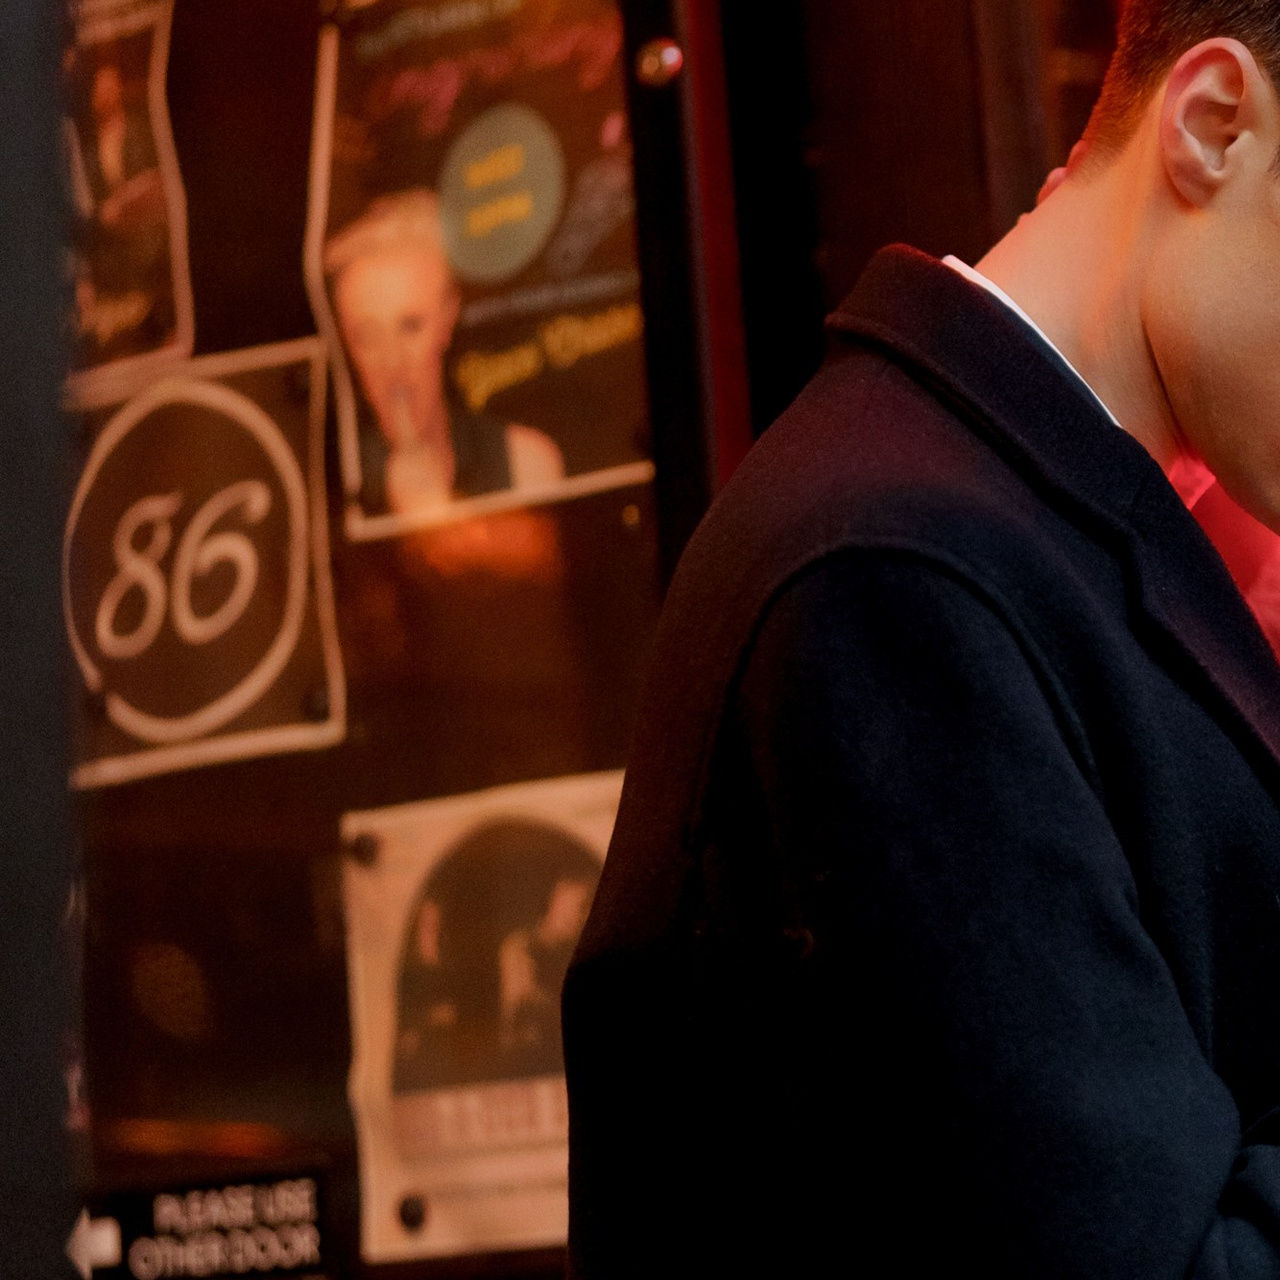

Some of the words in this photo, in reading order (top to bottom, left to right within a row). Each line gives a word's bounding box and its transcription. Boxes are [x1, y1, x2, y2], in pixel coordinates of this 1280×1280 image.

[97, 480, 271, 659] 86
[153, 1185, 254, 1232] PLEASE
[256, 1178, 318, 1225] USE
[228, 1223, 320, 1272] DOOR
